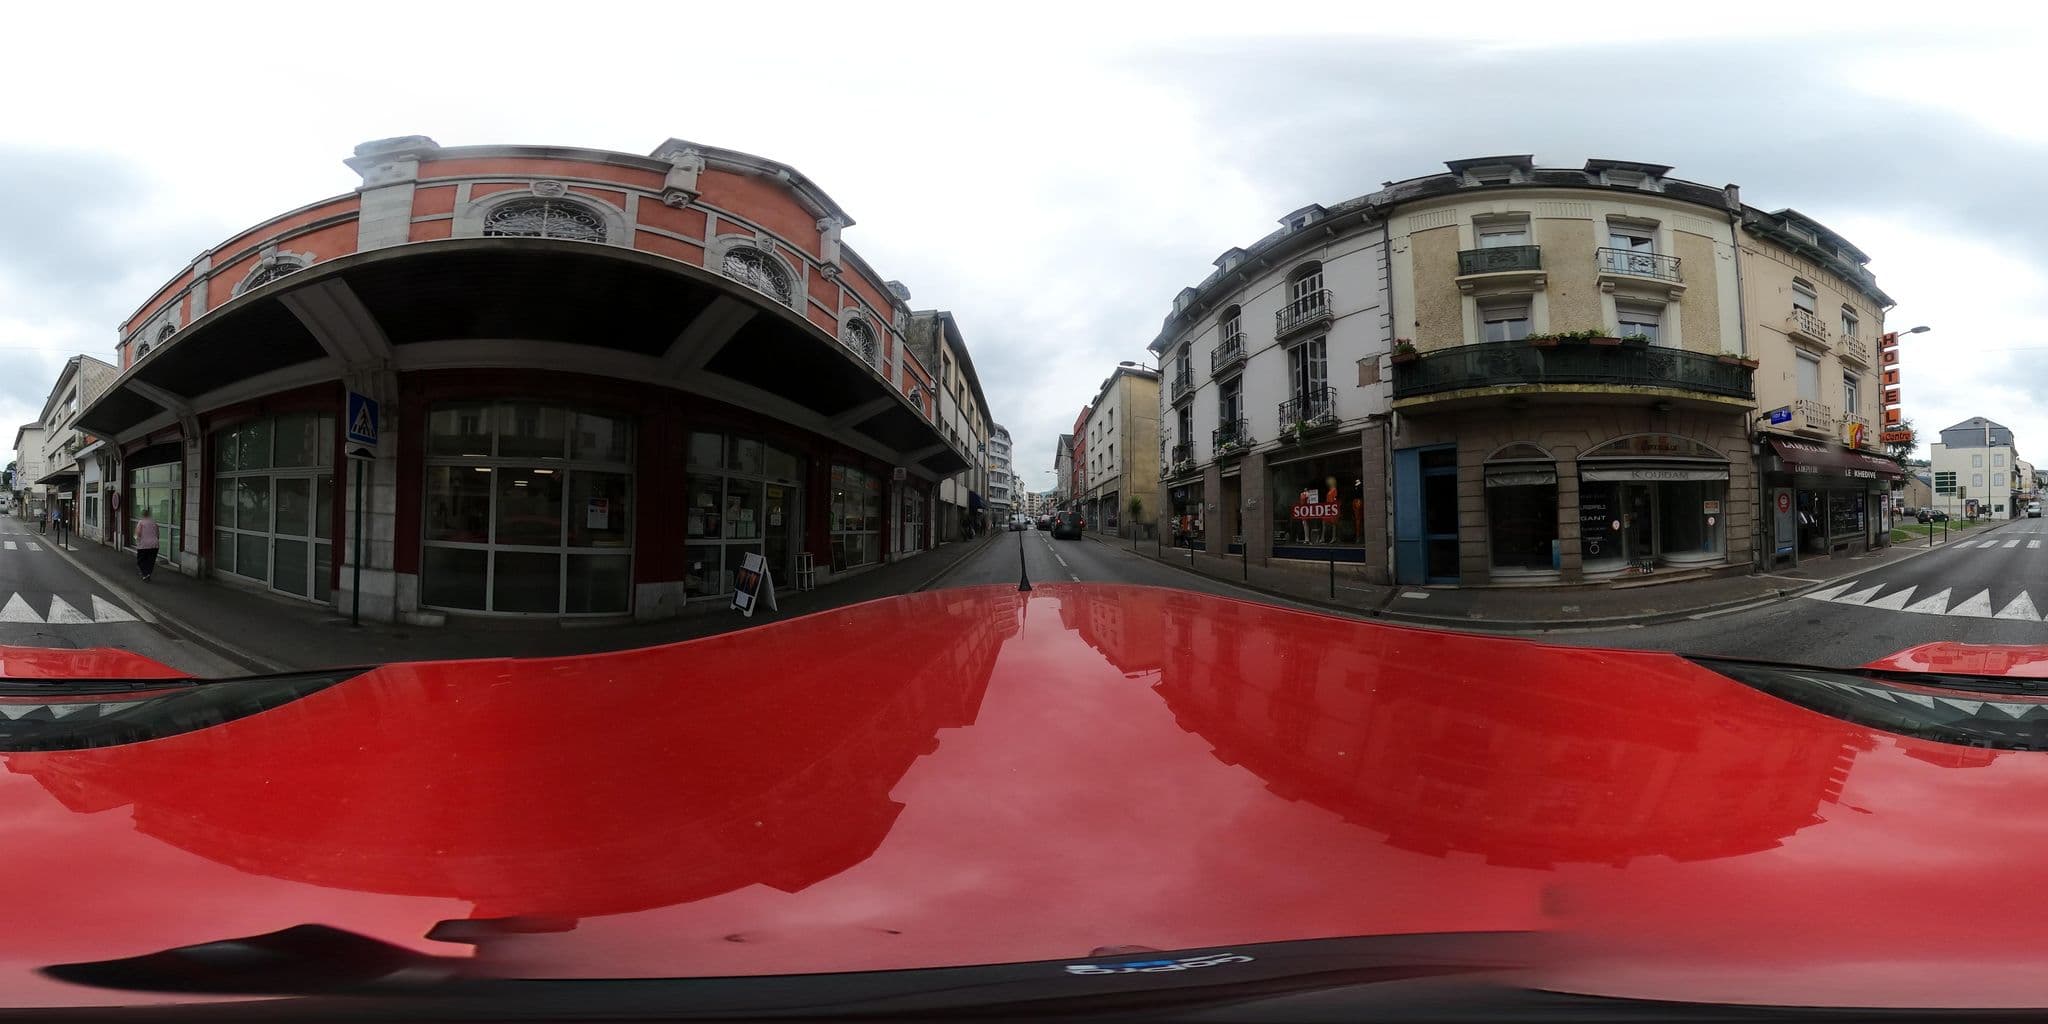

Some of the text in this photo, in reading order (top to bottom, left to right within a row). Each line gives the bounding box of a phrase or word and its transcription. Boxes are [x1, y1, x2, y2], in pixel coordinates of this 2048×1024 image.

[1883, 334, 1897, 423] HOTEL
[1886, 432, 1910, 441] Centre
[1645, 471, 1689, 480] QUIDAM
[1845, 469, 1852, 477] LE
[1293, 503, 1339, 518] SOLDES
